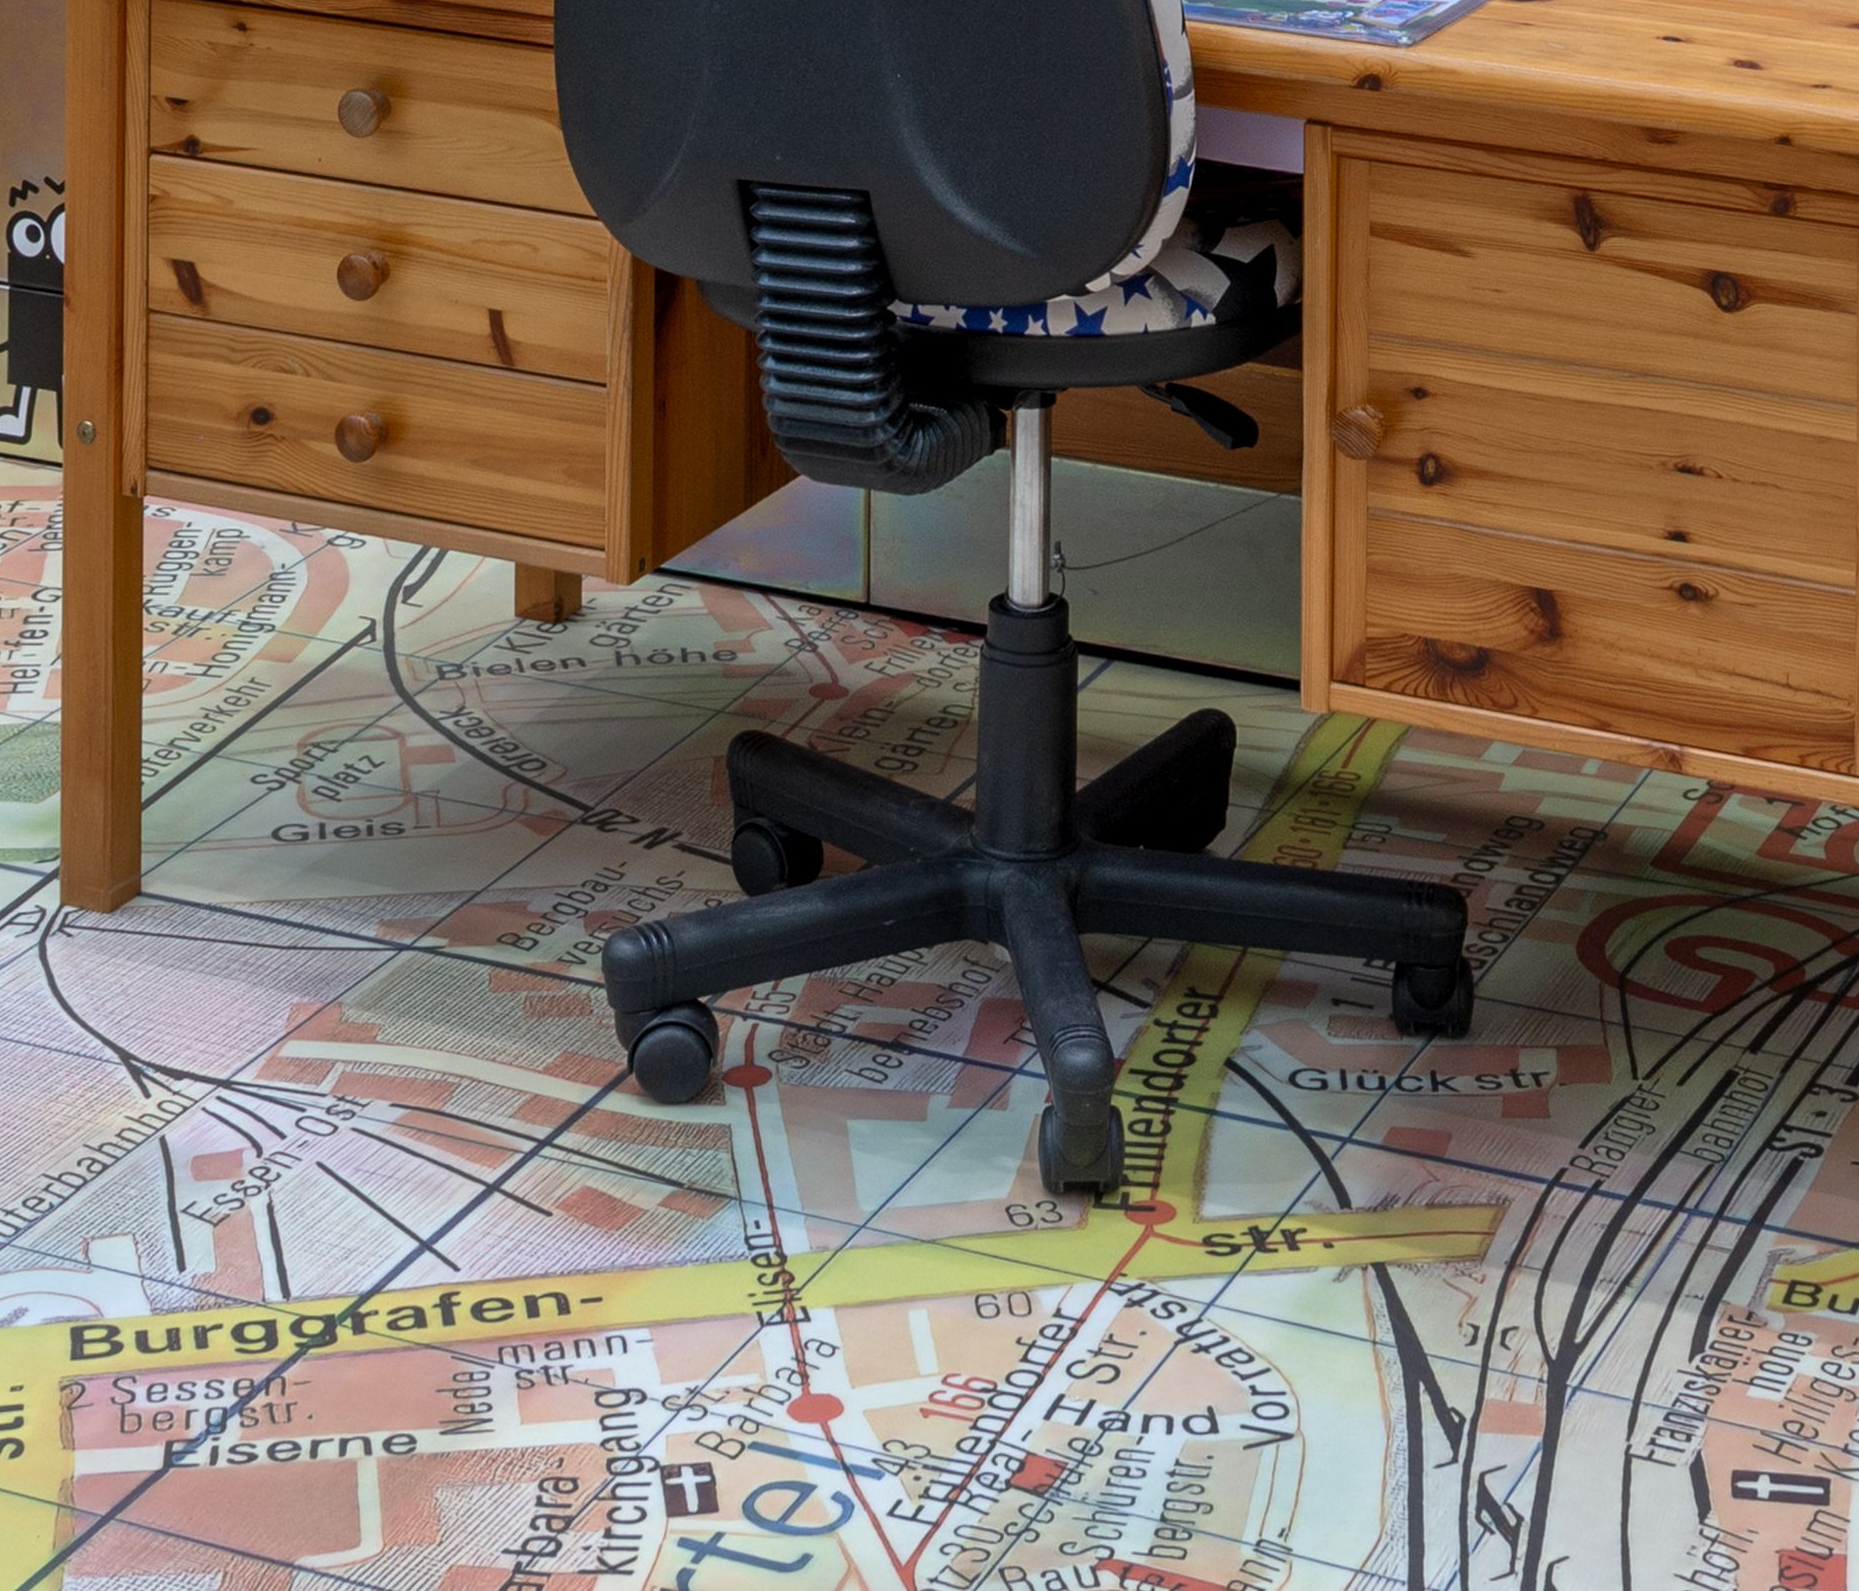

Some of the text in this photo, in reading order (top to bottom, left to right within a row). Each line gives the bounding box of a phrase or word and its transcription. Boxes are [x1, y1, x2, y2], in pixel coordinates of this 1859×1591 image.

[586, 582, 695, 650] gärten
[435, 643, 740, 683] Bielen höhe
[311, 752, 388, 805] platz
[270, 819, 431, 844] Gleis-
[495, 857, 628, 956] Bergbau-
[1091, 983, 1228, 1213] Frillendorfer
[1004, 1201, 1065, 1228] 63
[1201, 1225, 1337, 1258] str.
[67, 1288, 606, 1364] Burggrafen-
[974, 1290, 1034, 1320] 60
[496, 1333, 655, 1366] mann-
[109, 1373, 313, 1407] Sessen-
[694, 1333, 841, 1462] Barbara
[919, 1372, 999, 1423] 166
[117, 1402, 317, 1435] bergstr.
[160, 1427, 421, 1471] Eiserne
[596, 1383, 662, 1580] kirchgang
[1142, 1452, 1216, 1561] bergstr.
